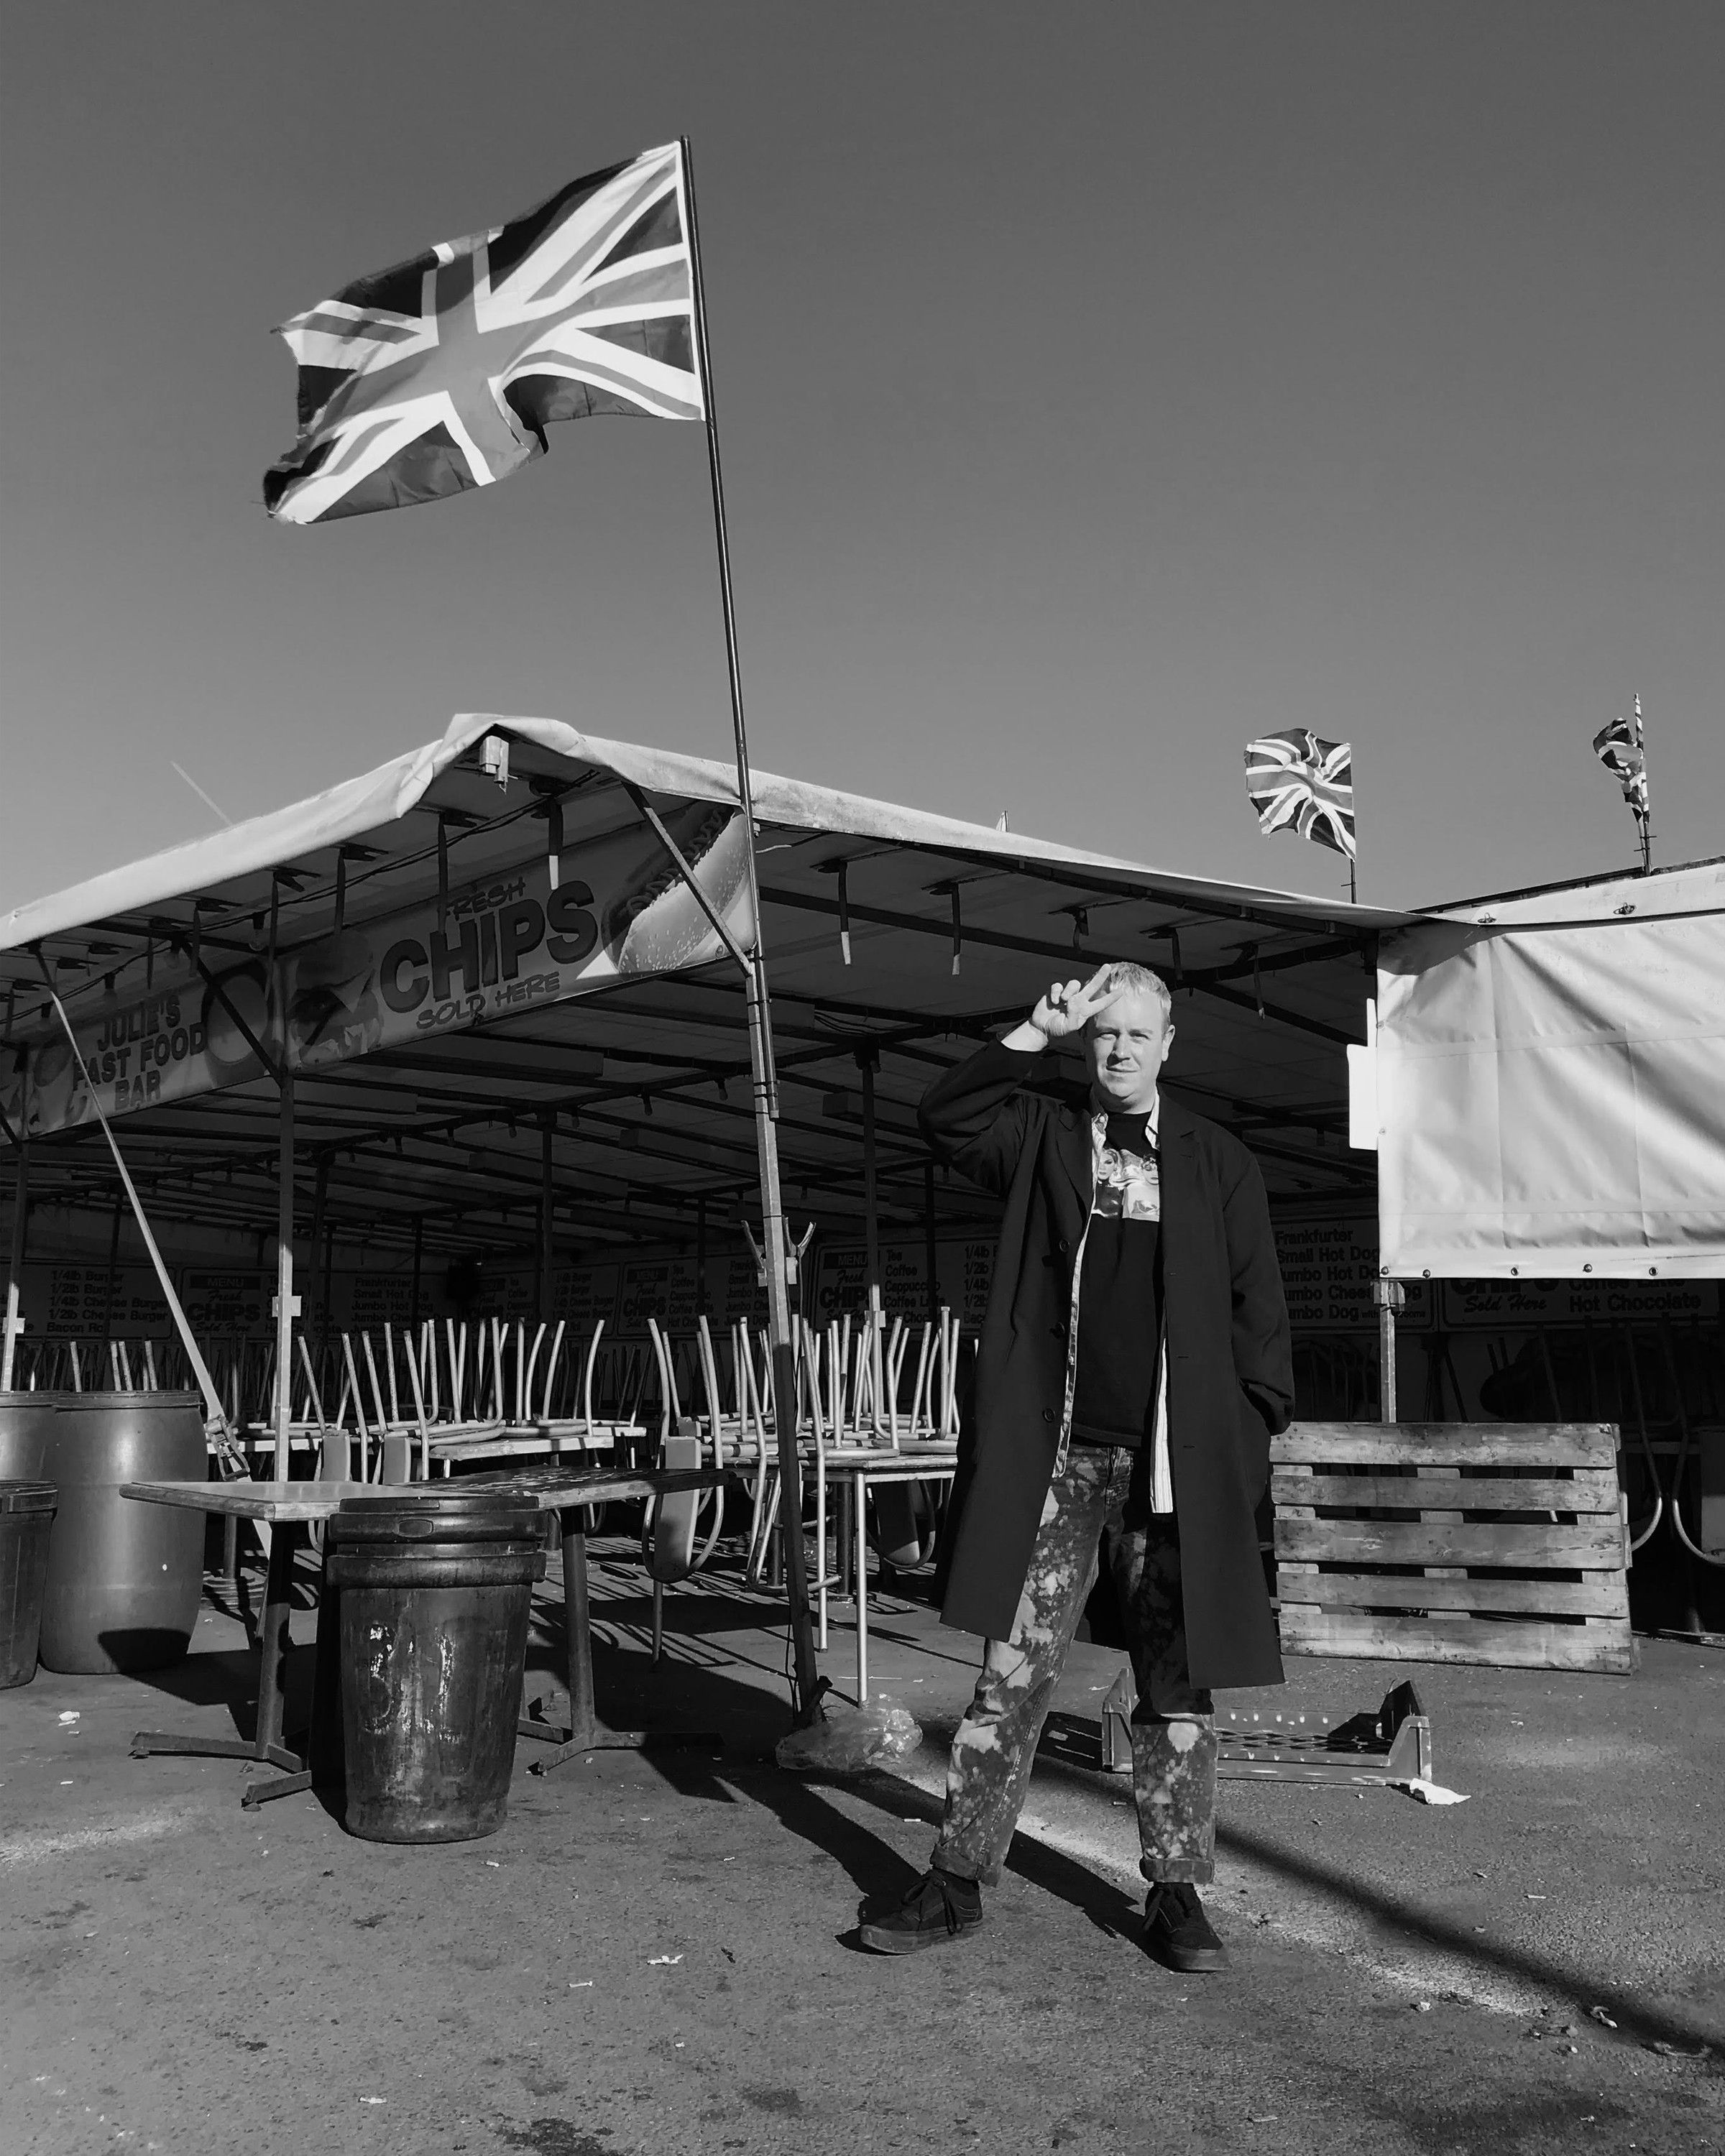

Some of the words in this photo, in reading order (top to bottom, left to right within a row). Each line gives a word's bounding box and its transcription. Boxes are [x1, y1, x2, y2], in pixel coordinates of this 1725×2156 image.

[380, 880, 597, 1013] CHIPS
[416, 994, 485, 1029] SOLD
[495, 972, 559, 1007] HERE
[98, 995, 180, 1051] JULIE'S
[73, 1047, 131, 1090] FAST
[140, 1021, 208, 1072] FOOD
[115, 1069, 161, 1110] BAR
[1275, 1229, 1353, 1244] Frankfurter
[886, 1249, 903, 1261] Tea
[965, 1245, 989, 1259] 1/4lb
[1276, 1247, 1313, 1263] Small
[1319, 1248, 1346, 1262] Hot
[1350, 1245, 1379, 1263] Dog
[838, 1254, 868, 1266] MENU
[886, 1265, 918, 1277] Coffee
[964, 1261, 989, 1274] 1/2lb
[1328, 1266, 1353, 1281] Hot
[1359, 1265, 1379, 1279] Do
[52, 1270, 81, 1281] 1/4lb
[50, 1283, 79, 1294] 1/2lb
[207, 1278, 244, 1287] MENU
[671, 1277, 695, 1288] Coffee
[885, 1280, 941, 1294] Cappucco
[964, 1278, 988, 1291] 1/4lb
[206, 1291, 243, 1302] Fresh
[408, 1290, 429, 1302] Dg
[669, 1291, 711, 1301] Cappuco
[727, 1287, 752, 1298] Jumbo
[820, 1286, 869, 1309] CHIP
[1284, 1286, 1322, 1301] umbo
[351, 1302, 387, 1311] Jumbo
[413, 1302, 433, 1312] og
[624, 1296, 666, 1317] CHIPS
[725, 1302, 750, 1312] Jumbo
[884, 1295, 916, 1307] Coffee
[920, 1294, 945, 1307] Lte
[1464, 1295, 1502, 1312] Sold
[1507, 1293, 1547, 1312] Here
[1570, 1294, 1601, 1313] Hot
[1608, 1292, 1701, 1312] Chocolate
[48, 1309, 78, 1319] 1/2lb
[187, 1303, 260, 1322] CHIPS
[668, 1303, 692, 1314] Coffee
[1289, 1305, 1323, 1319] mbo
[1330, 1304, 1358, 1322] Dog
[351, 1313, 386, 1322] Jumbo
[47, 1322, 85, 1332] Bacon
[88, 1322, 109, 1332] Ro
